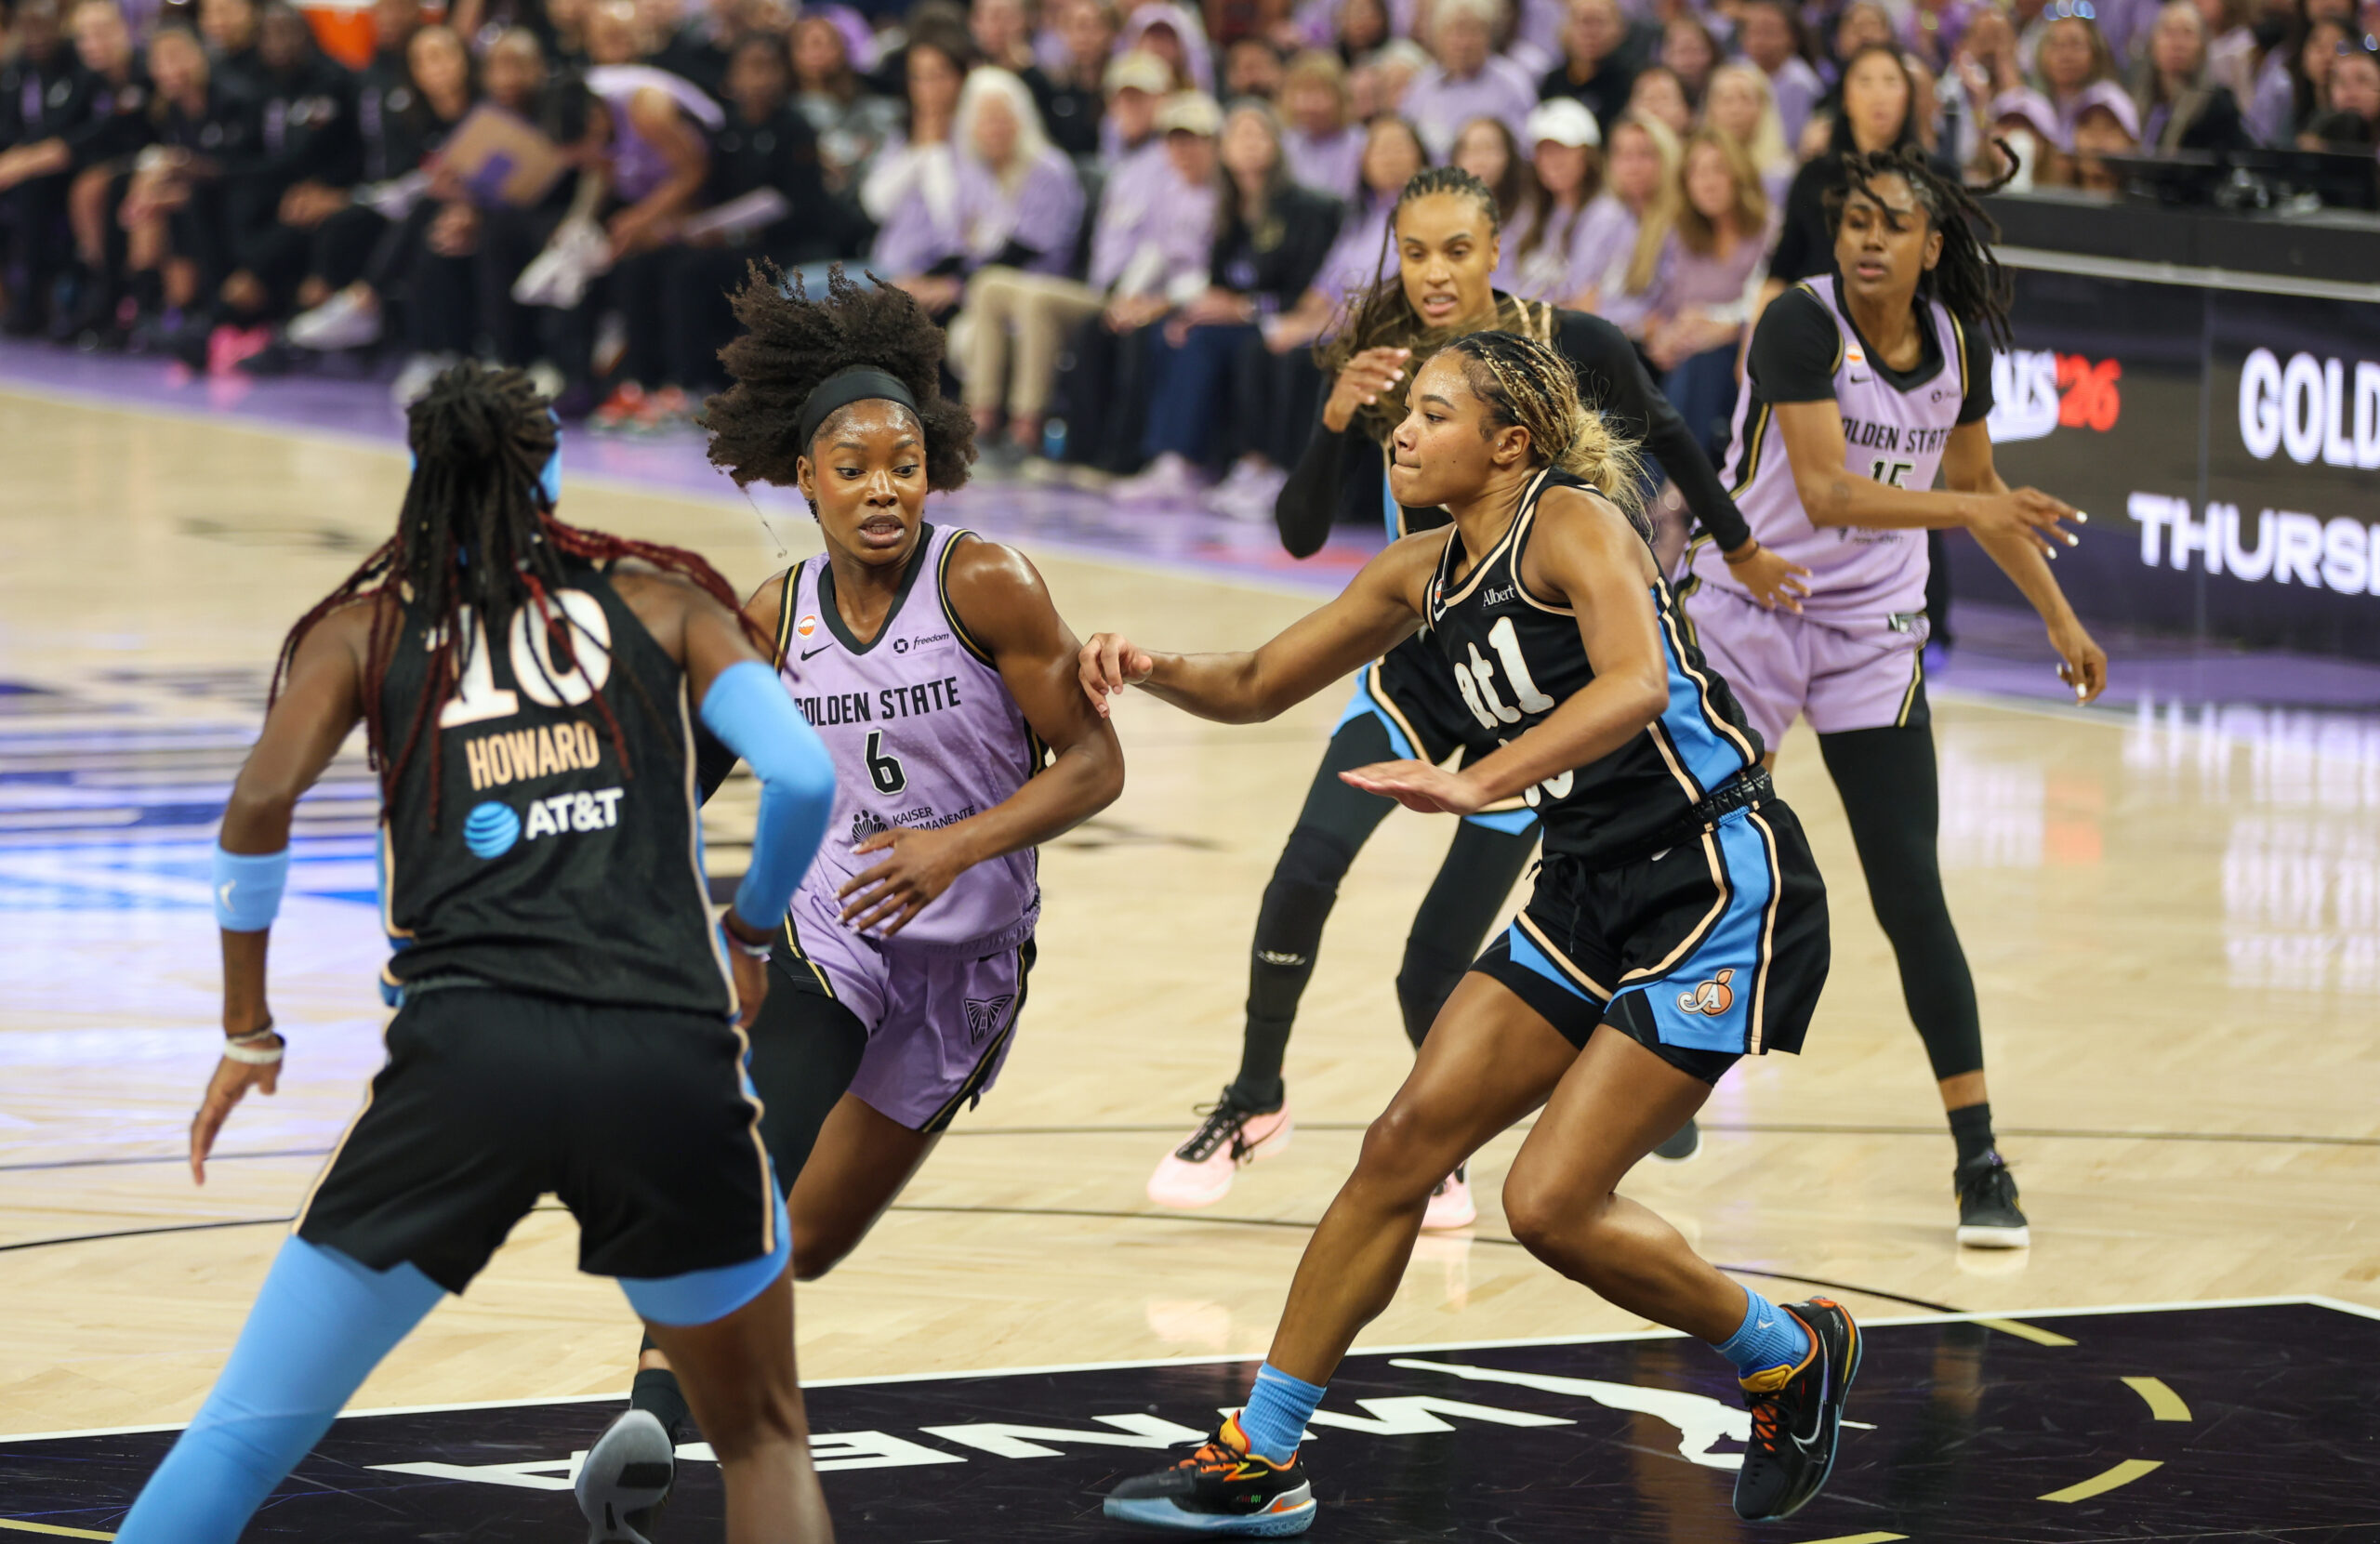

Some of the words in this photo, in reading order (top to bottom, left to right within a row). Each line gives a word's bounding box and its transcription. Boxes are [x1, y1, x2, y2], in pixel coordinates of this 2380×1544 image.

[1841, 418, 1899, 453] OLDEN
[2127, 491, 2380, 597] THURS
[1482, 584, 1515, 608] Albert
[426, 587, 612, 729] 10
[913, 632, 949, 651] freedom
[879, 676, 961, 720] STATE
[466, 719, 601, 791] HOWARD
[864, 729, 907, 796] 6
[524, 786, 624, 840] AT&T
[892, 806, 934, 825] KAISER
[908, 805, 976, 831] MANENTE
